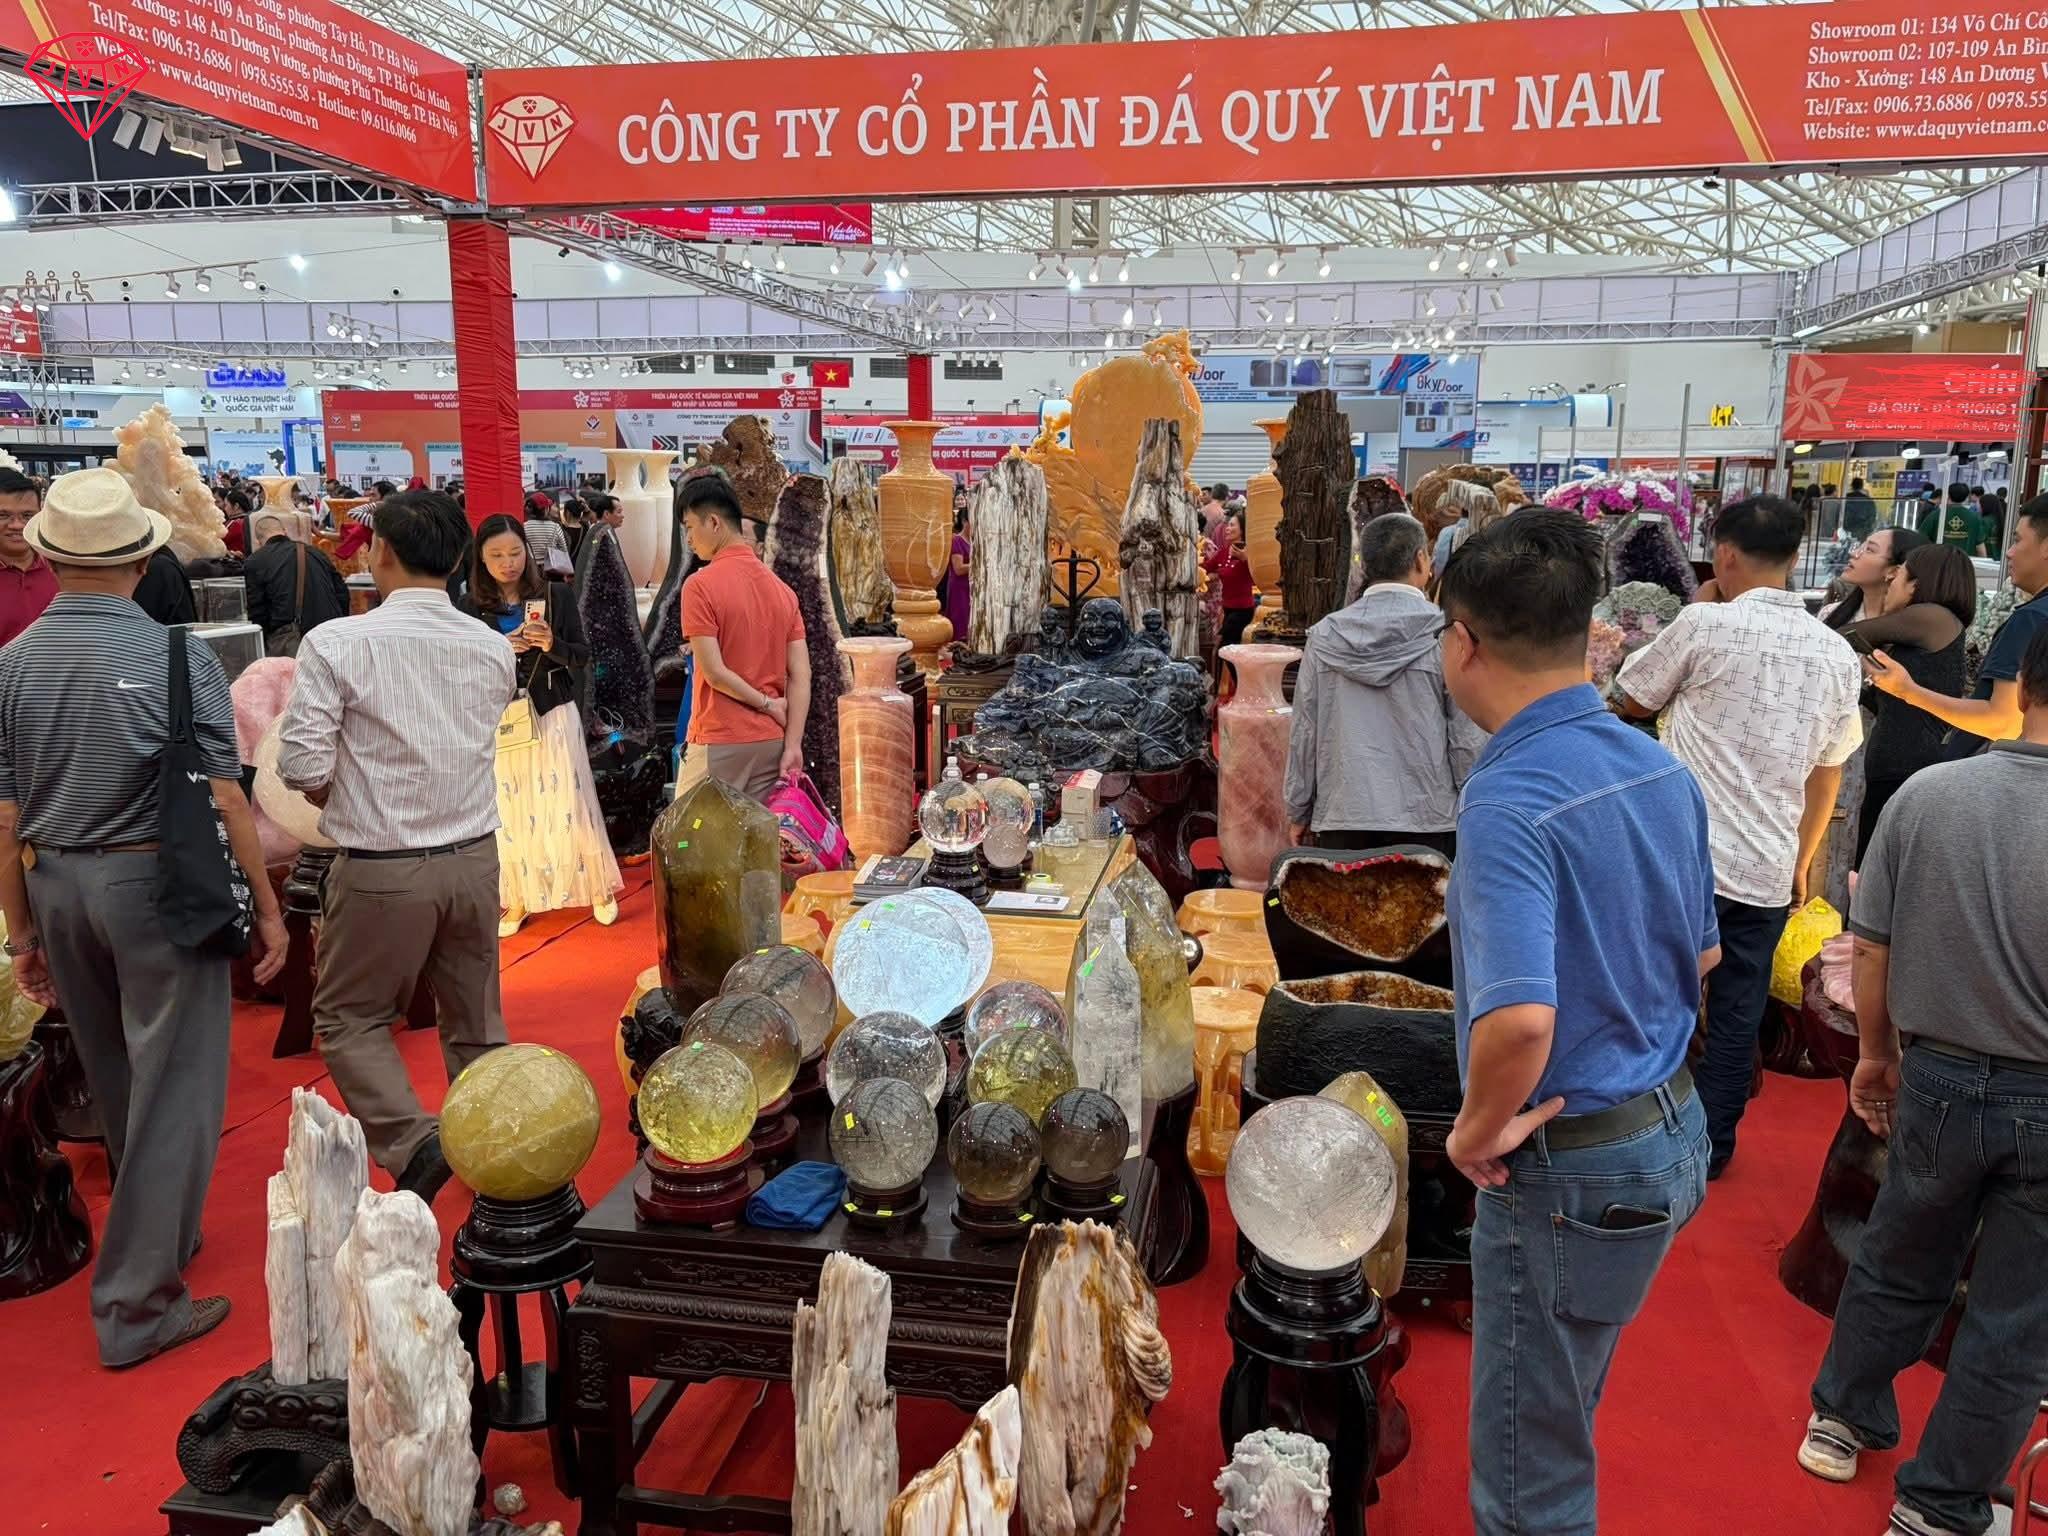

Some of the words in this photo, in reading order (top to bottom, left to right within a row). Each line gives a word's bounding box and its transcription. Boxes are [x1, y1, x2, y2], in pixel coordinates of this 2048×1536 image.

[236, 6, 253, 28] An
[255, 13, 287, 45] Bình,
[288, 30, 328, 63] phường
[330, 46, 344, 67] An
[346, 53, 376, 83] Đông,
[394, 74, 409, 96] Hồ
[409, 82, 426, 102] Chí
[428, 90, 451, 113] Minh
[288, 8, 327, 39] phường
[328, 21, 348, 48] Tây
[387, 48, 401, 67] Hà
[402, 57, 419, 79] Nội
[1808, 46, 1894, 65] Showroom
[1898, 43, 1922, 61] 02:
[1927, 40, 1989, 60] 107-109
[1992, 38, 2017, 57] An
[1810, 20, 1896, 40] Showroom
[1901, 17, 1925, 36] 01:
[1929, 15, 1957, 34] 134
[1963, 14, 1985, 33] Võ
[1990, 12, 2021, 31] Chí
[88, 2, 149, 42] Tel/Fax:
[152, 29, 232, 73] 0906.73.6886
[241, 61, 309, 102] 0978.5555.58
[317, 90, 359, 121] Hotline:
[159, 61, 320, 131] www.daquyvietnam.com.vn
[184, 10, 207, 34] 148
[210, 21, 228, 43] An
[230, 27, 270, 64] Dương
[312, 64, 350, 96] phường
[352, 79, 371, 101] Phú
[372, 87, 411, 120] Thượng,
[428, 112, 441, 131] Hà
[443, 119, 458, 139] Nội
[1806, 71, 1840, 89] Kho
[1855, 68, 1914, 89] Xưởng:
[1919, 67, 1947, 85] 148
[1950, 65, 1974, 83] An
[1979, 64, 2036, 85] Dương
[617, 98, 760, 165] CÔNG
[775, 106, 841, 158] TY
[856, 73, 928, 157] CỔ
[946, 66, 1100, 153] PHẦN
[1119, 71, 1203, 148] ĐÁ
[1221, 66, 1340, 154] QUÝ
[1357, 62, 1495, 151] VIỆT
[1511, 68, 1665, 131] NAM
[1803, 121, 1871, 141] Website:
[1805, 97, 1868, 118] Tel/Fax:
[1874, 93, 1973, 114] 0906.73.6886
